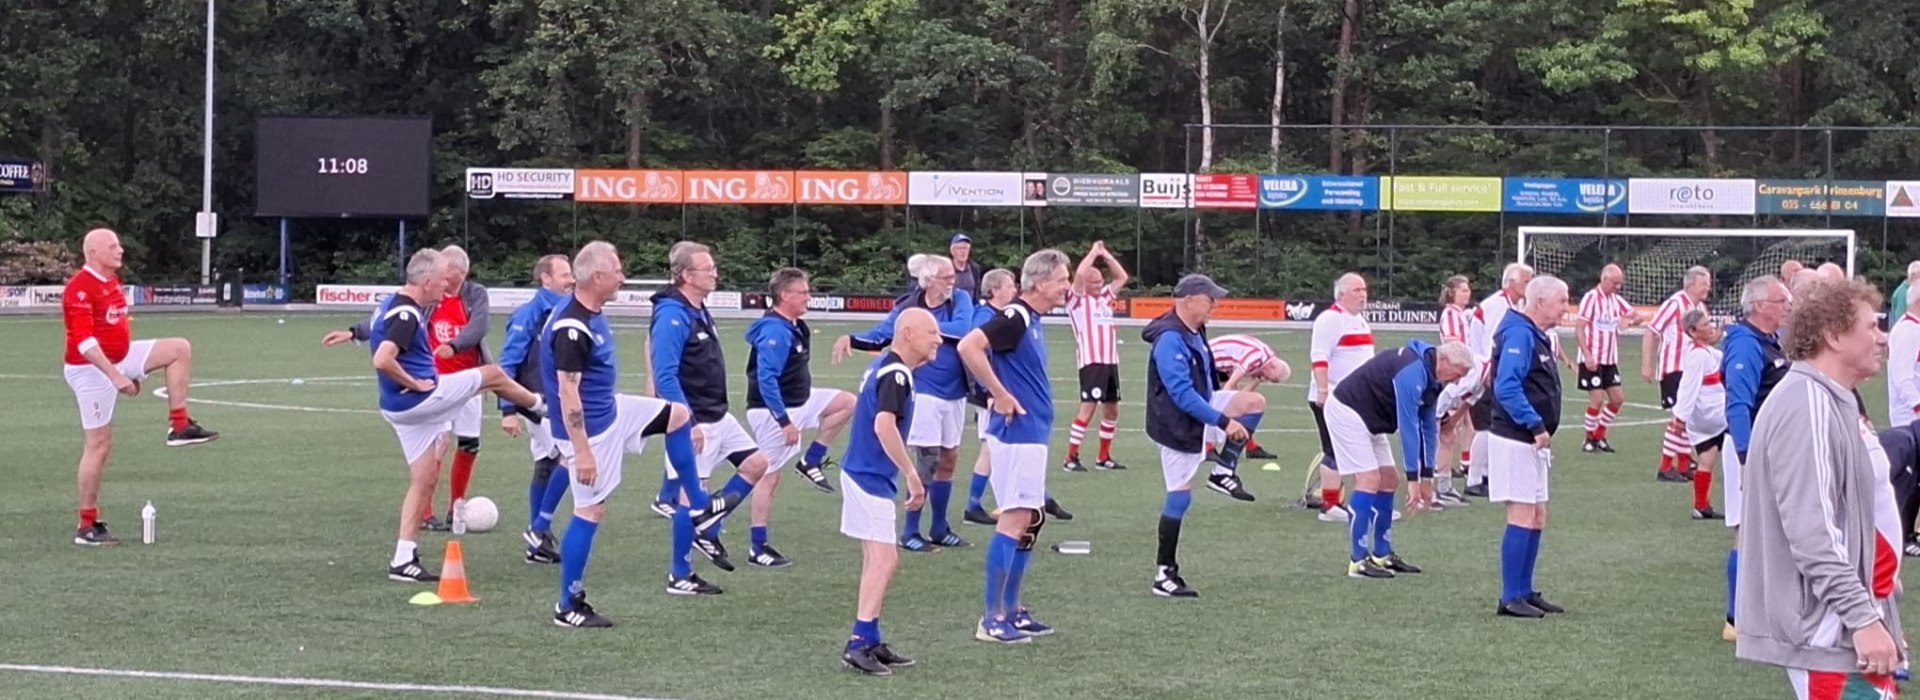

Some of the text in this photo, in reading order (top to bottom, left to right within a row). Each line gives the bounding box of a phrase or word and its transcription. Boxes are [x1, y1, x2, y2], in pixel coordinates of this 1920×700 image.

[317, 157, 368, 174] 11:08
[471, 175, 492, 189] HD
[497, 172, 571, 182] HD SECURITY
[580, 176, 637, 198] ING
[689, 178, 748, 200] ING
[802, 178, 861, 200] ING
[1579, 183, 1616, 196] VELEA
[320, 288, 371, 302] fischer
[1362, 310, 1438, 322] RTE DUINEN
